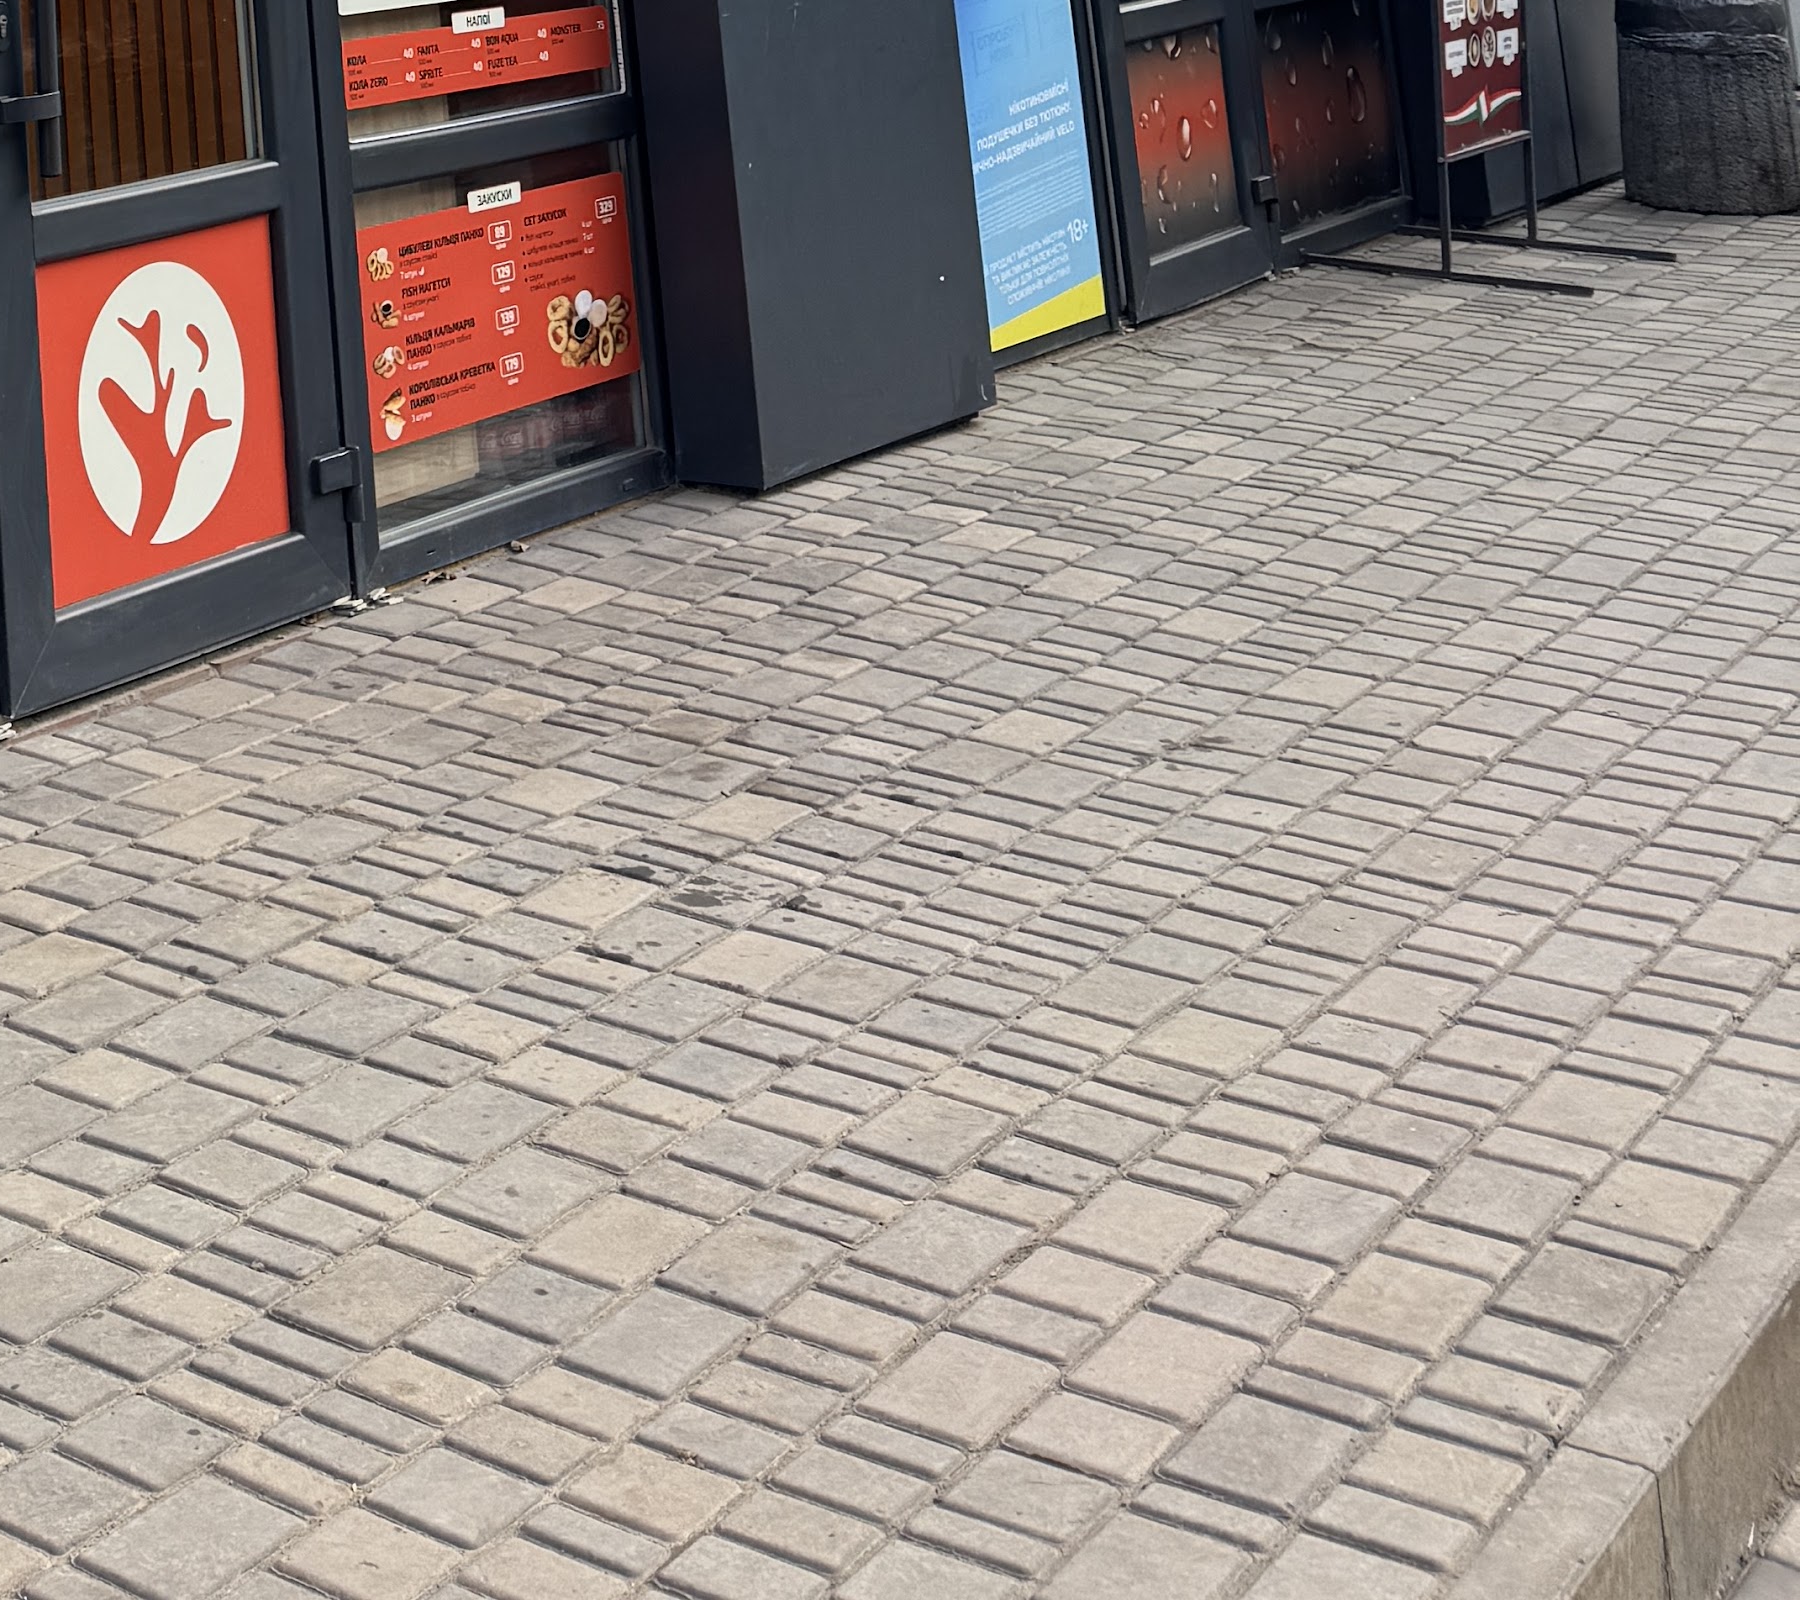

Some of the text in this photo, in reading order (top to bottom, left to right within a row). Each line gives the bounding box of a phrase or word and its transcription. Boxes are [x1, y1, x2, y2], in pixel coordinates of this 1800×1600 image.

[466, 13, 491, 27] НАПОЇ
[551, 24, 581, 36] MONSTER
[370, 68, 443, 88] ZERO SPRITE
[477, 189, 512, 206] ЗАКУСКИ
[524, 216, 539, 226] СЕТ
[1067, 219, 1089, 243] 18+
[402, 286, 417, 299] FISH
[407, 344, 432, 361] ПАНКО
[459, 362, 495, 381] КРЕВЕТКА
[504, 357, 519, 371] 179
[410, 395, 435, 410] ПАНКО
